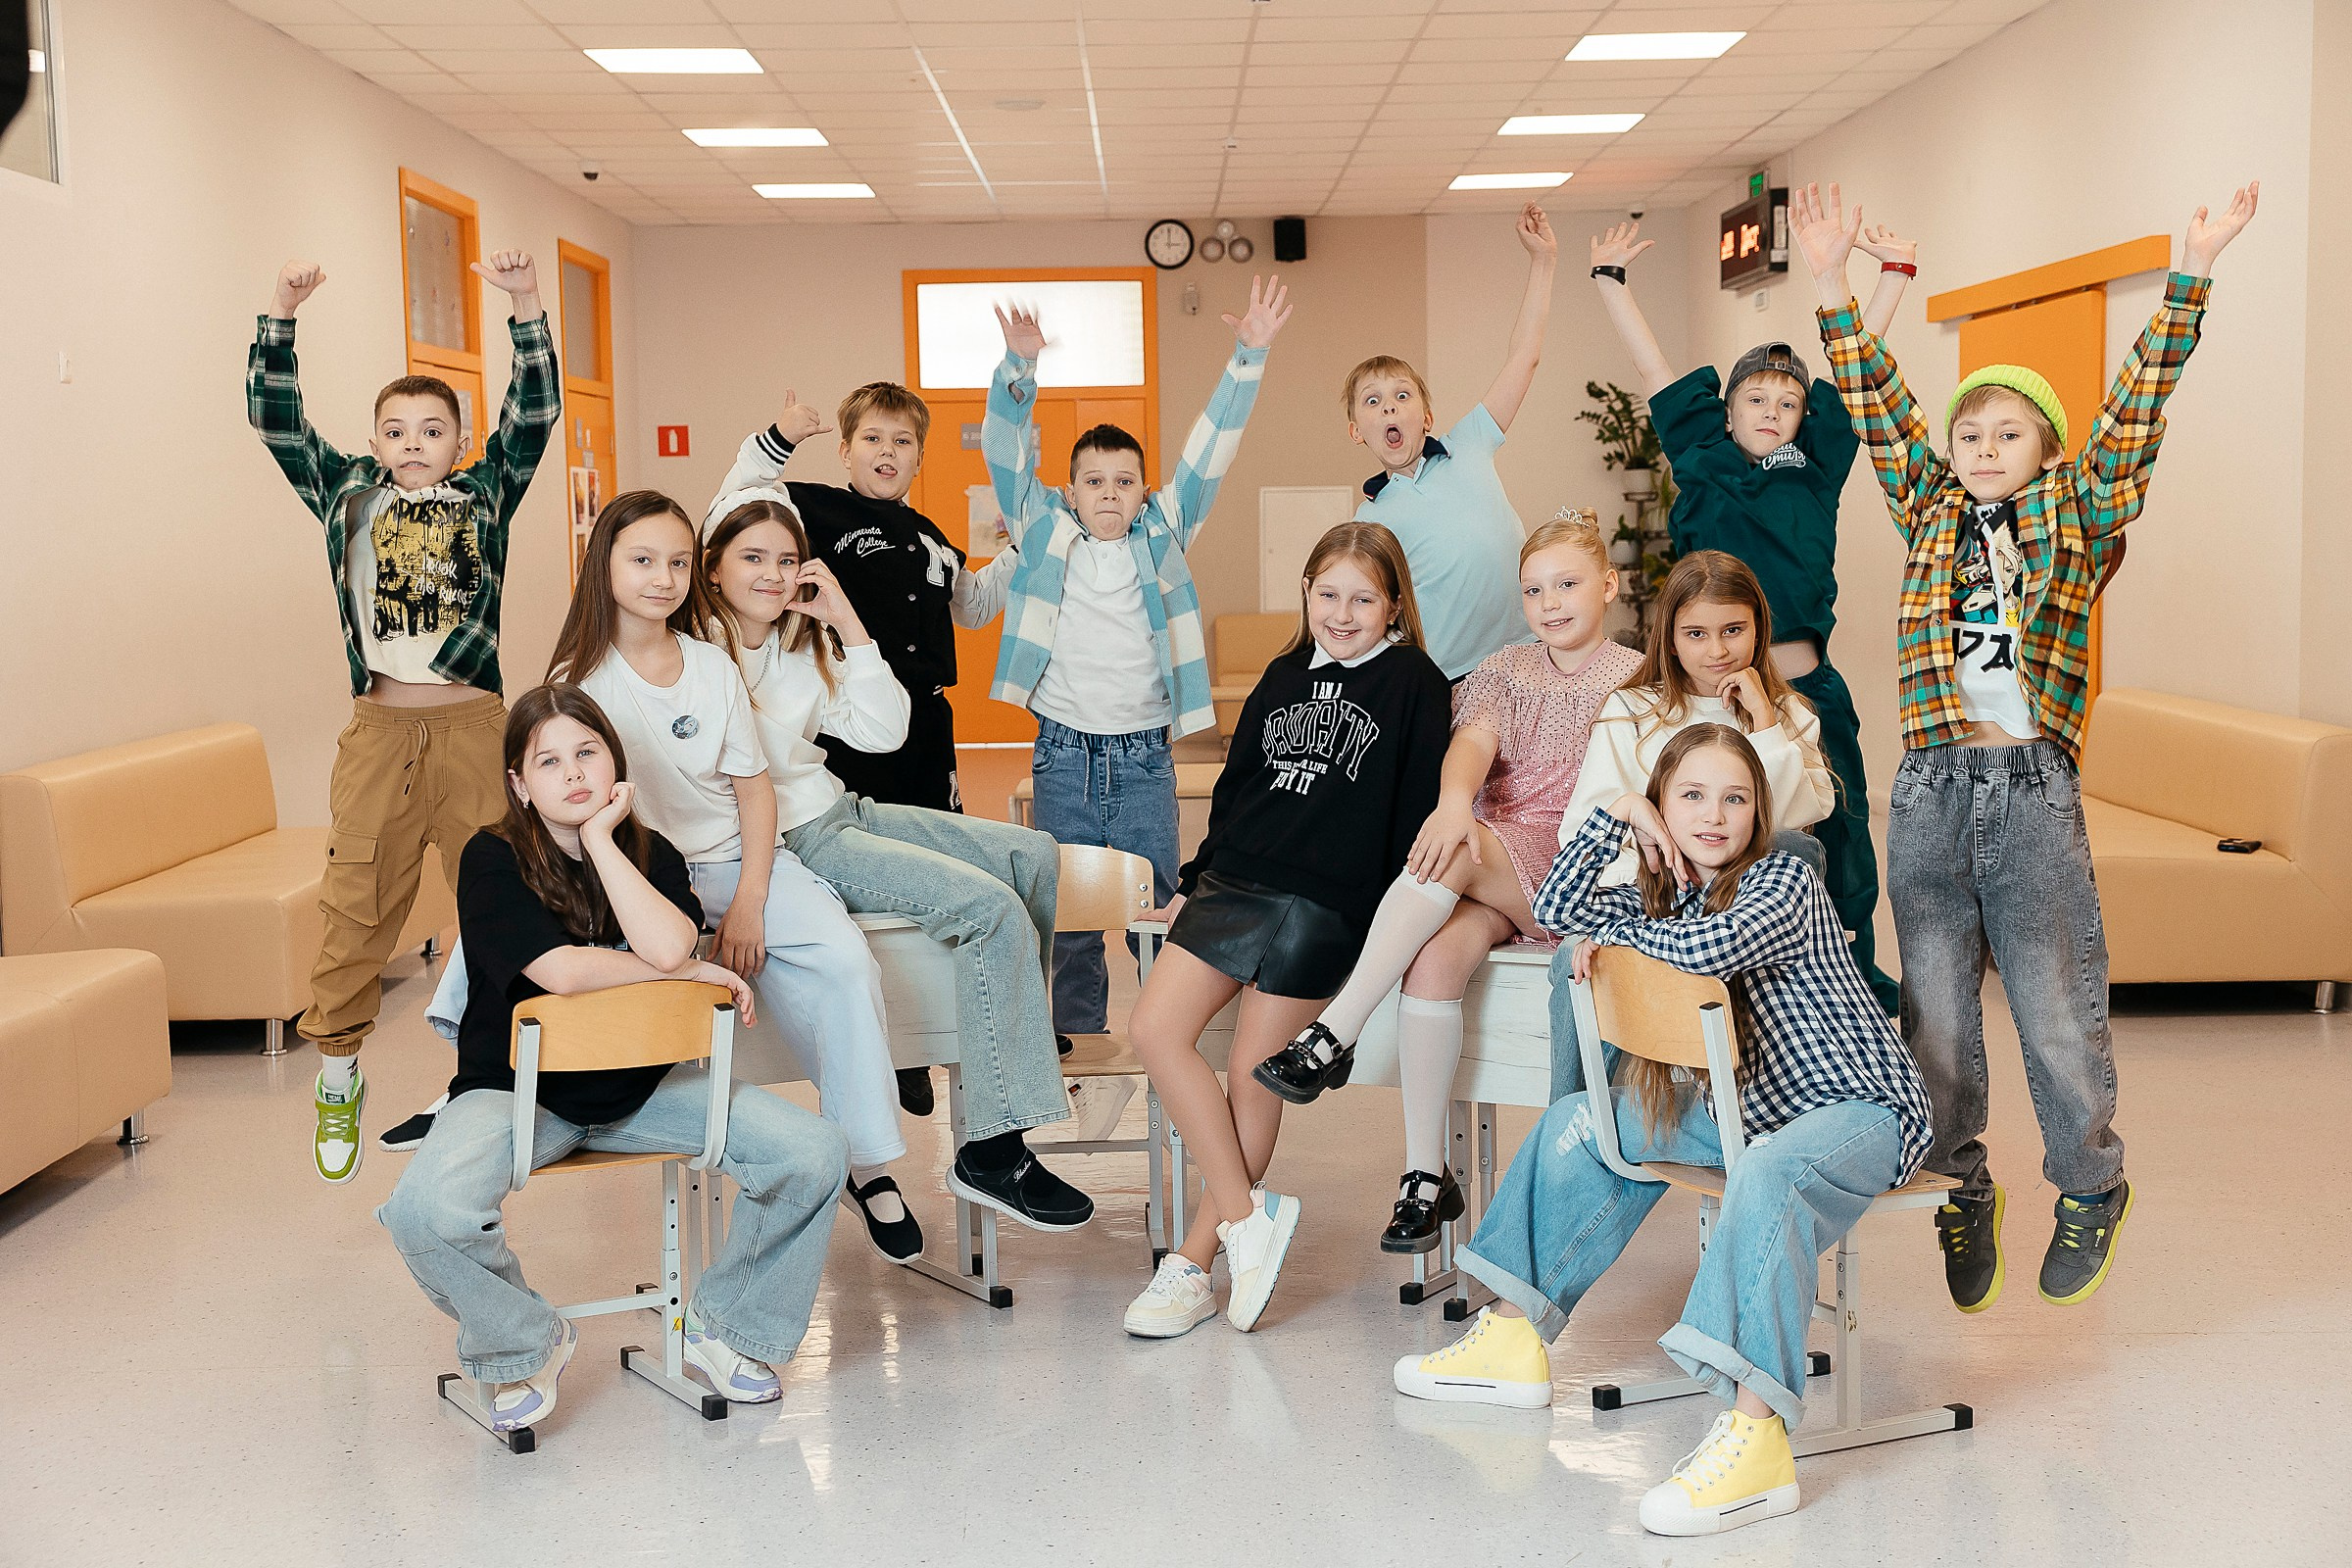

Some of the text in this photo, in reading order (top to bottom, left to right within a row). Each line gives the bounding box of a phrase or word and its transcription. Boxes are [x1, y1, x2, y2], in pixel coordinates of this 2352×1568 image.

[834, 526, 882, 554] Minnesota
[857, 536, 888, 556] College
[1312, 681, 1318, 700] I
[1318, 681, 1334, 700] AM
[1272, 760, 1293, 770] THIS
[1308, 760, 1328, 774] LIFE
[1296, 770, 1315, 795] IT
